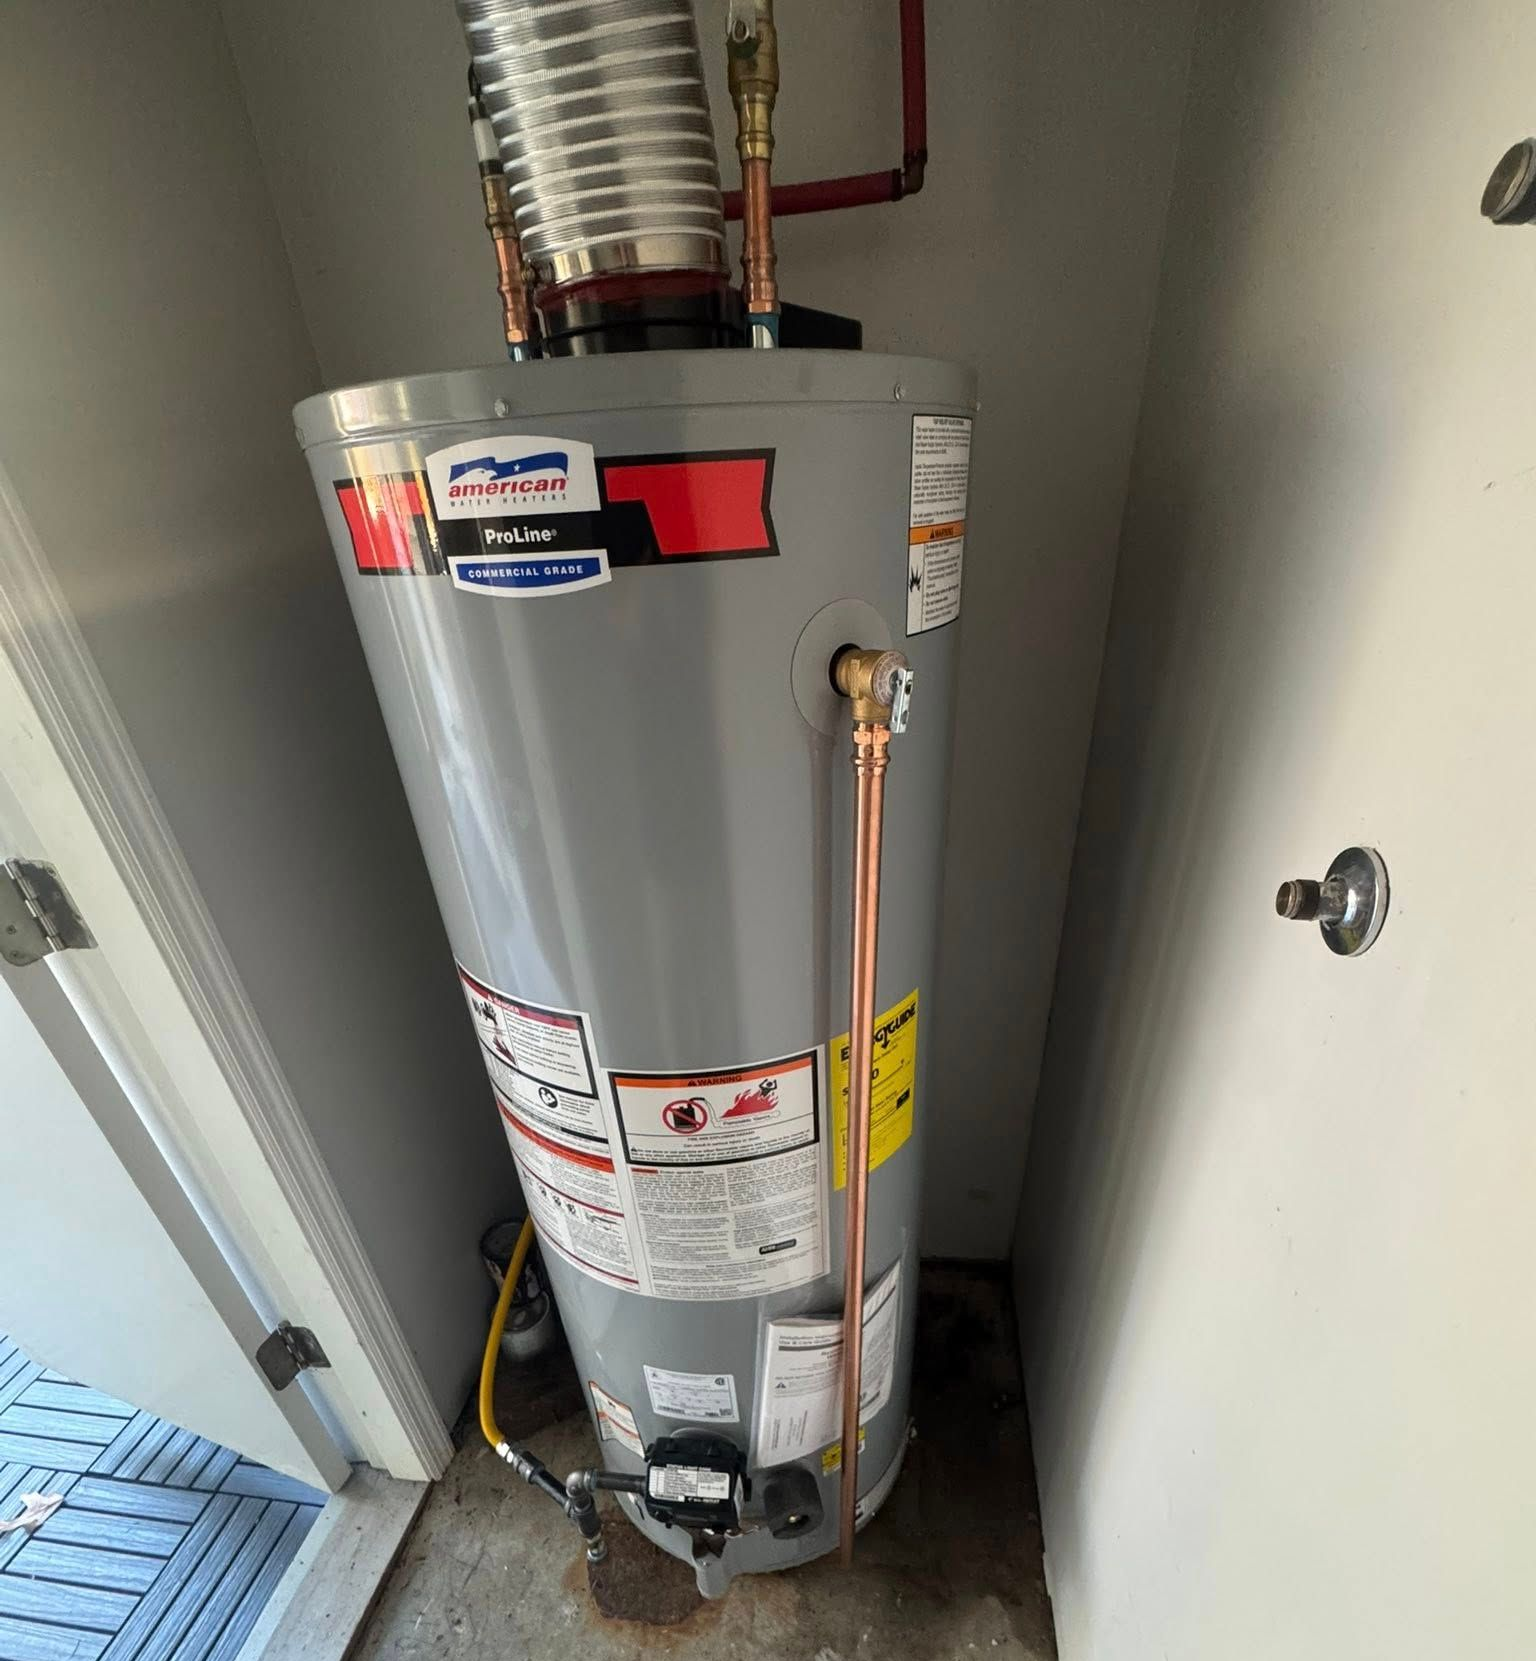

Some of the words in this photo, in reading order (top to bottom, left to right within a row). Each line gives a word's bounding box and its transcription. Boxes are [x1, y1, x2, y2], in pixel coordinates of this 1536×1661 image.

[448, 477, 567, 498] american
[450, 498, 490, 507] WATER
[502, 493, 567, 504] HEATERS
[468, 567, 539, 579] COMMERCIAL
[544, 565, 583, 575] GRADE
[697, 1075, 742, 1086] WARNING
